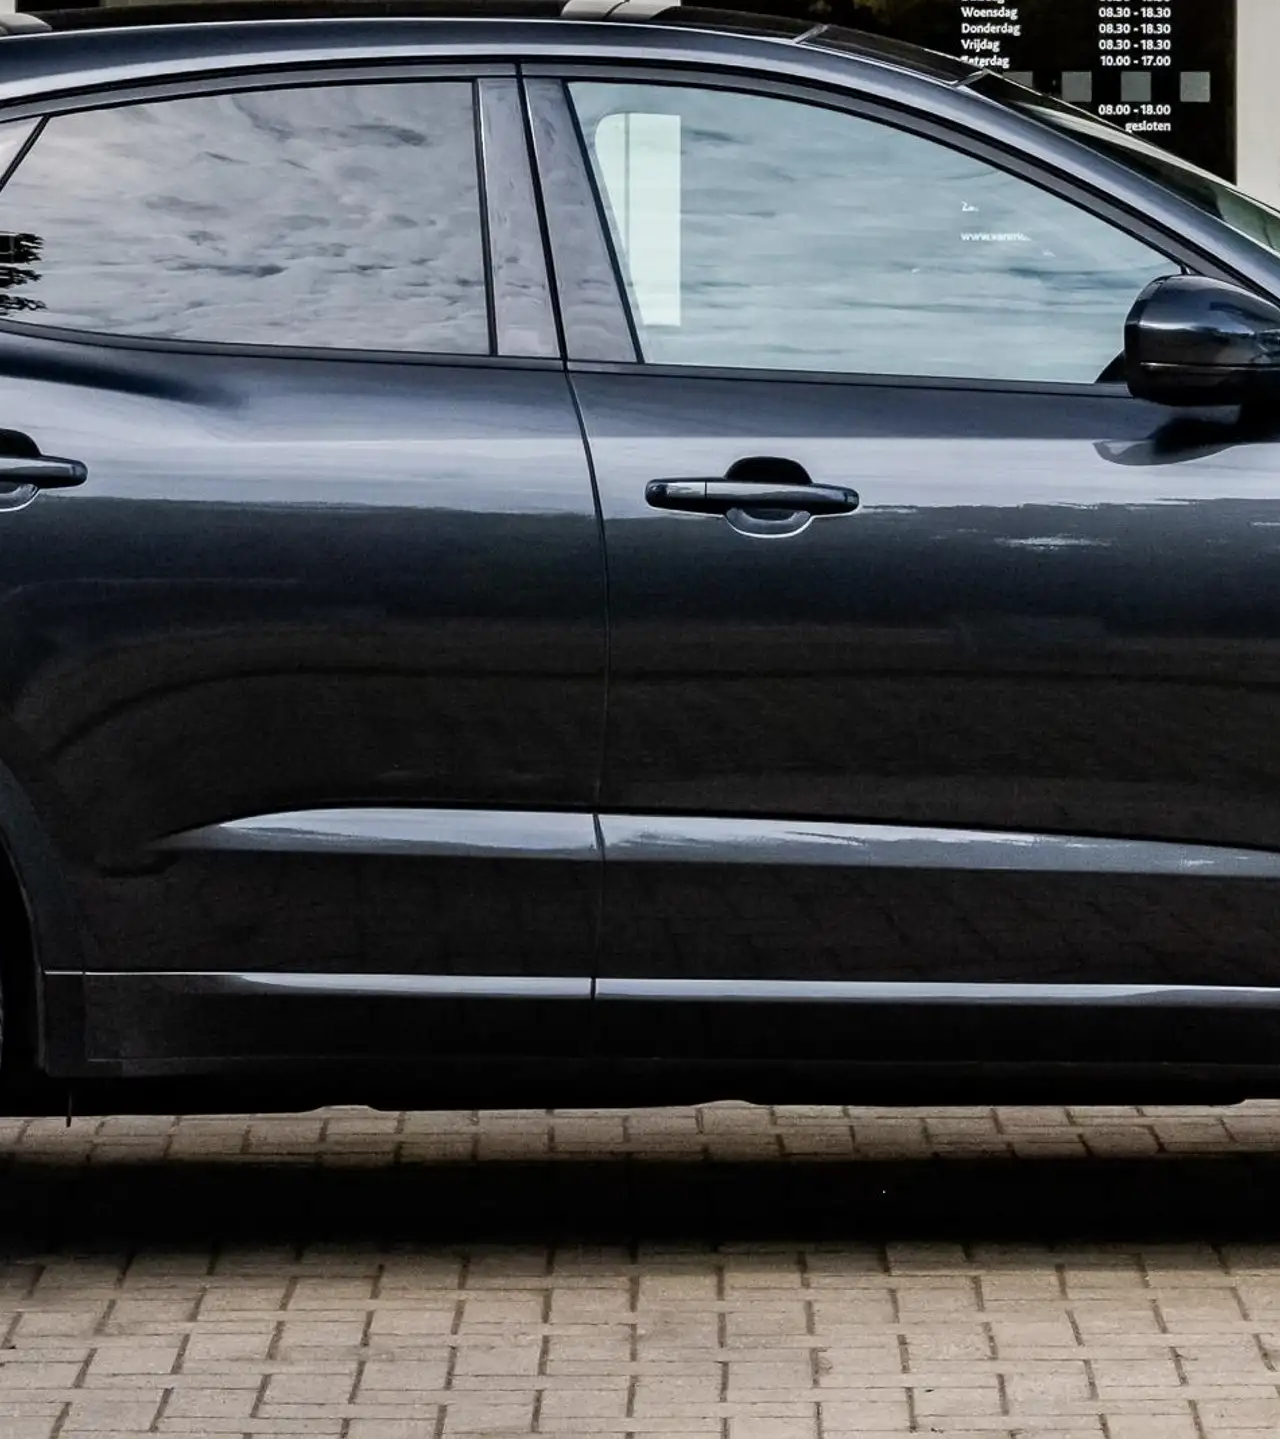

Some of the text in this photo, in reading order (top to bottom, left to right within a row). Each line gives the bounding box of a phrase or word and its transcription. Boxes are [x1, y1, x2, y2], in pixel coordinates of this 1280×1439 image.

[961, 6, 1018, 20] Woensdag
[1099, 7, 1130, 18] 08.30
[1141, 7, 1171, 18] 18.30
[961, 22, 1021, 36] Donderdag
[1099, 24, 1130, 35] 08.30
[1141, 24, 1171, 35] 18.30
[961, 38, 1000, 52] Vrijdag
[1099, 40, 1130, 51] 08.30
[1141, 40, 1171, 51] 18.30
[1100, 56, 1130, 67] 10.00
[1141, 56, 1171, 67] 17.00
[1098, 104, 1131, 115] 08.00
[1140, 104, 1171, 115] 18.00
[1125, 120, 1171, 133] gesloten
